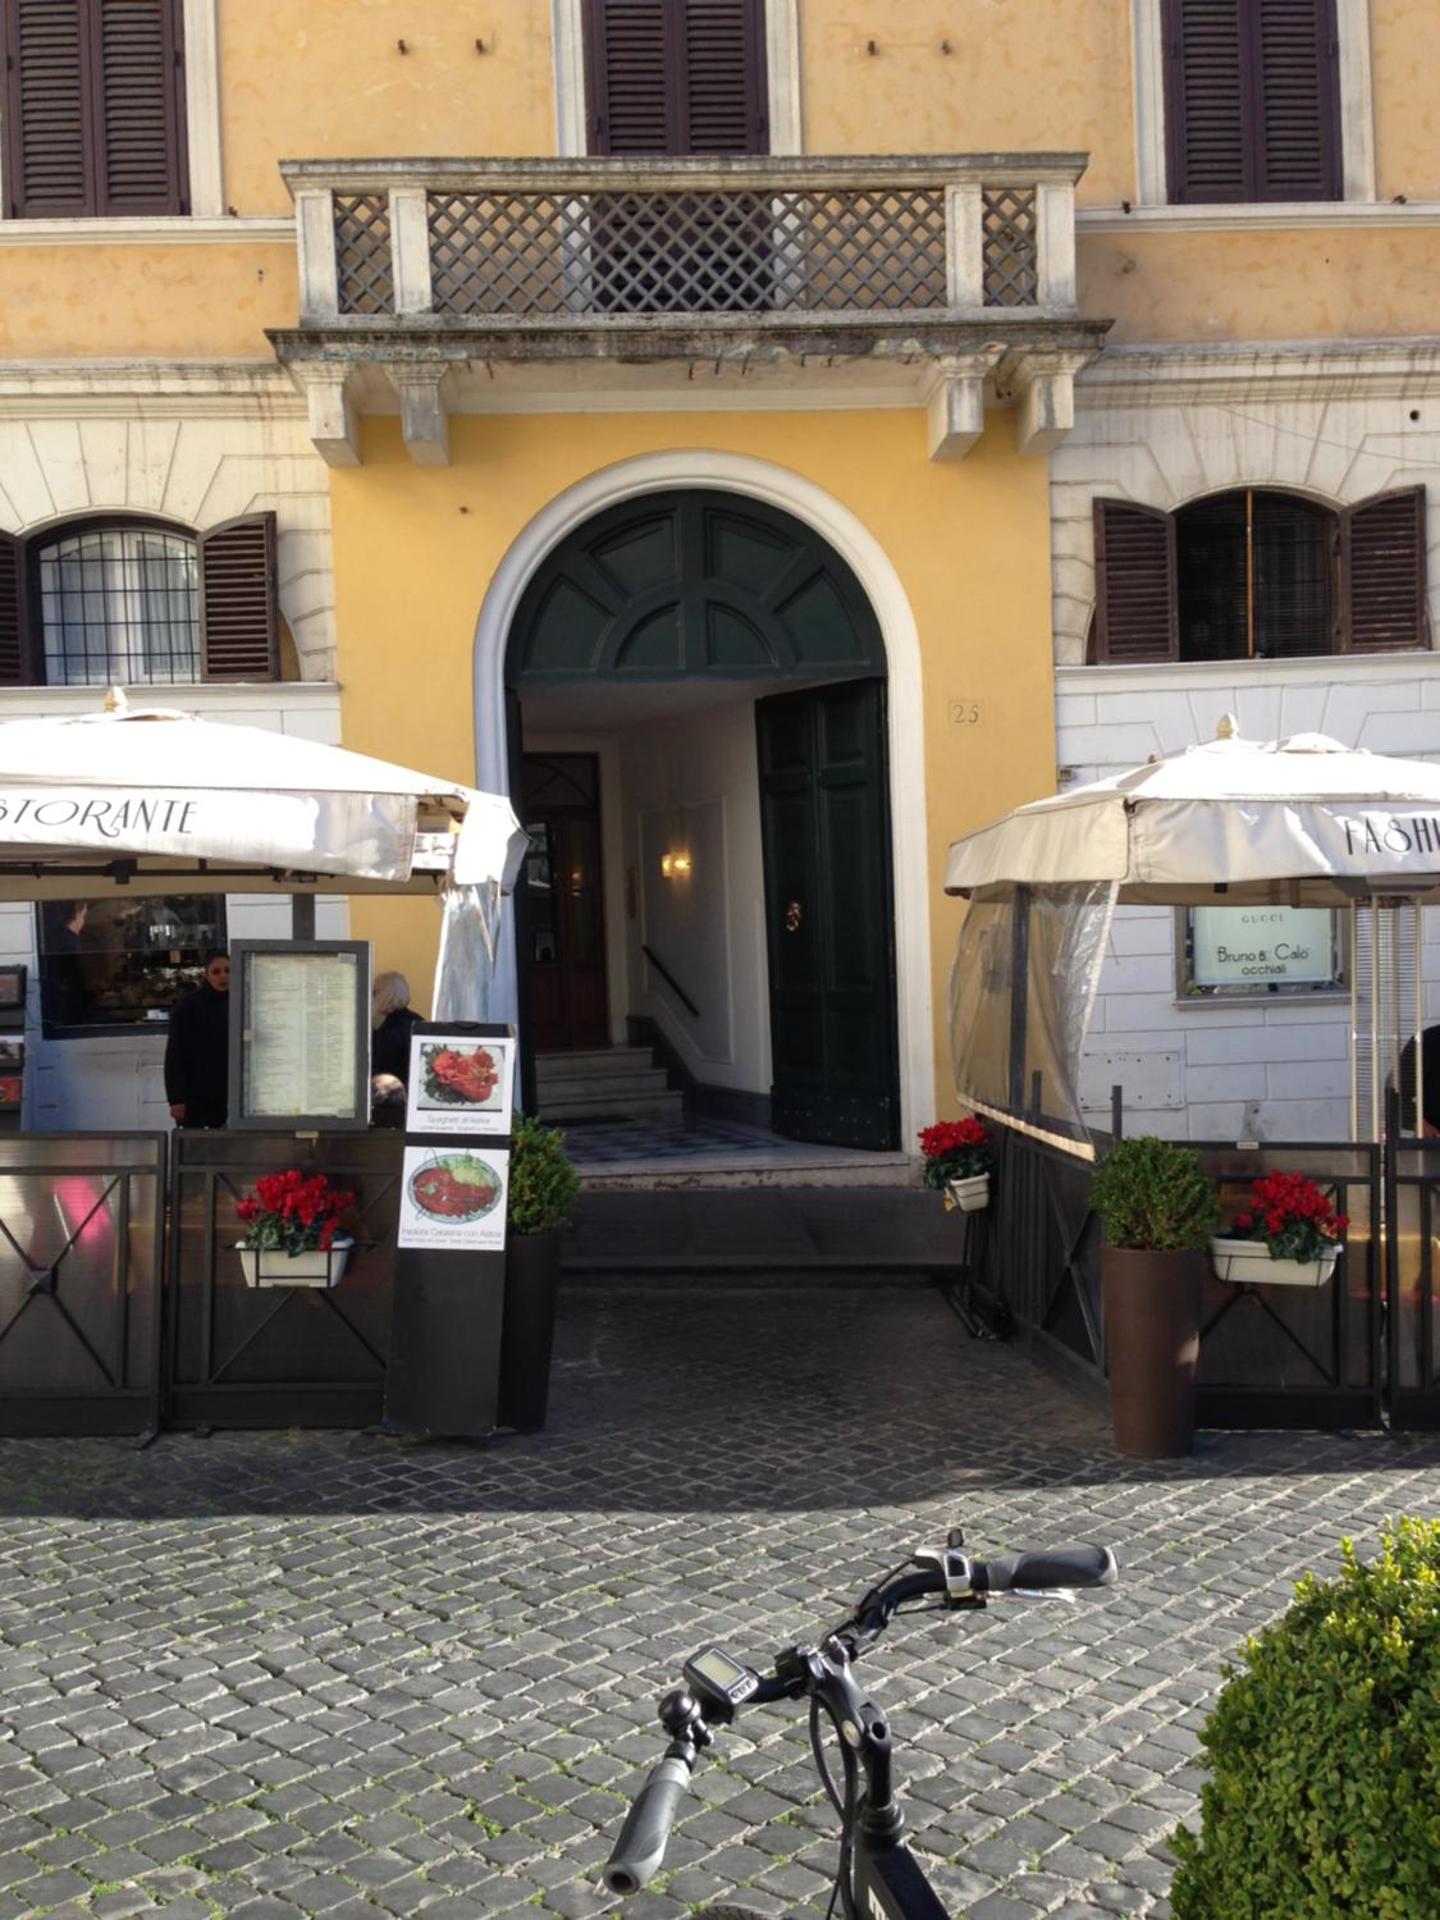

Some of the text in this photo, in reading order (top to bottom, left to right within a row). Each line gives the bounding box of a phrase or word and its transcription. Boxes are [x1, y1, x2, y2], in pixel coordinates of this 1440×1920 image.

[951, 704, 979, 724] 25
[1241, 913, 1284, 923] GUCCI
[1217, 946, 1257, 962] Bruno
[1241, 963, 1287, 975] occhiali
